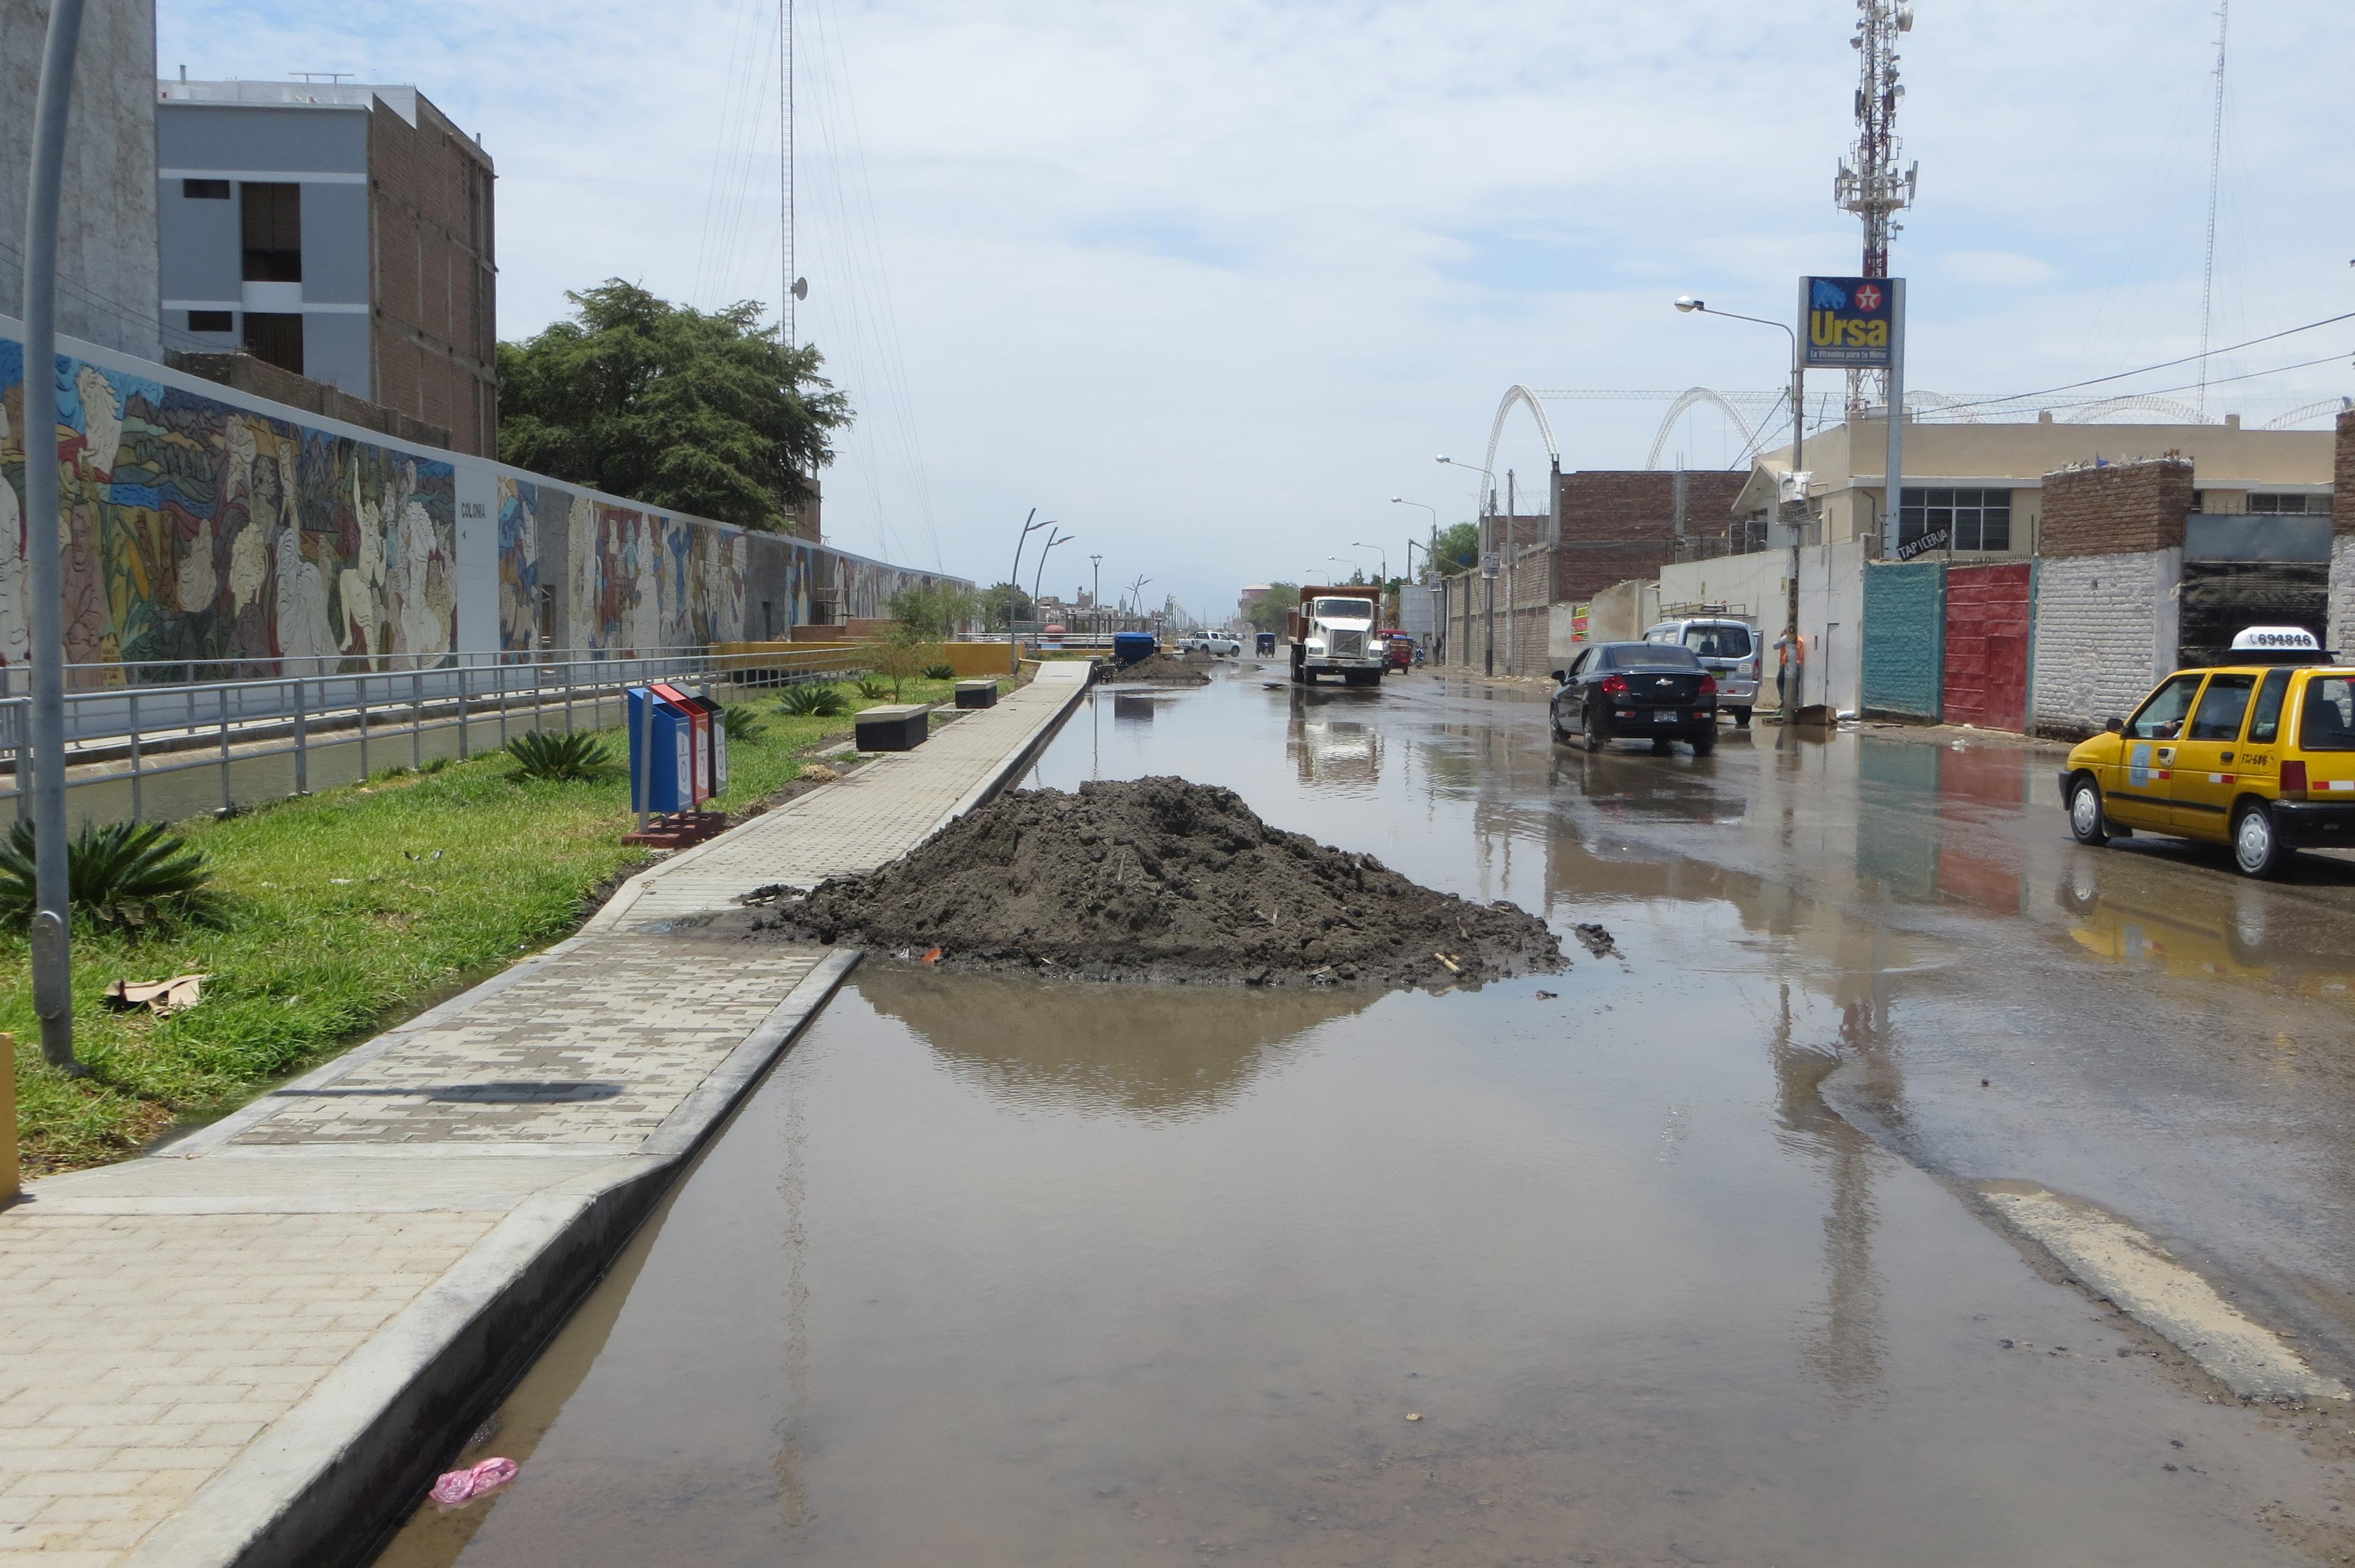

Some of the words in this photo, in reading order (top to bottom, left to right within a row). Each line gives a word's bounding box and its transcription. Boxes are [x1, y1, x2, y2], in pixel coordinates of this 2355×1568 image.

[1811, 311, 1888, 347] Ursa
[461, 502, 486, 519] COLONIA
[1898, 529, 1948, 559] TAPICERIA
[2258, 633, 2312, 647] 694846
